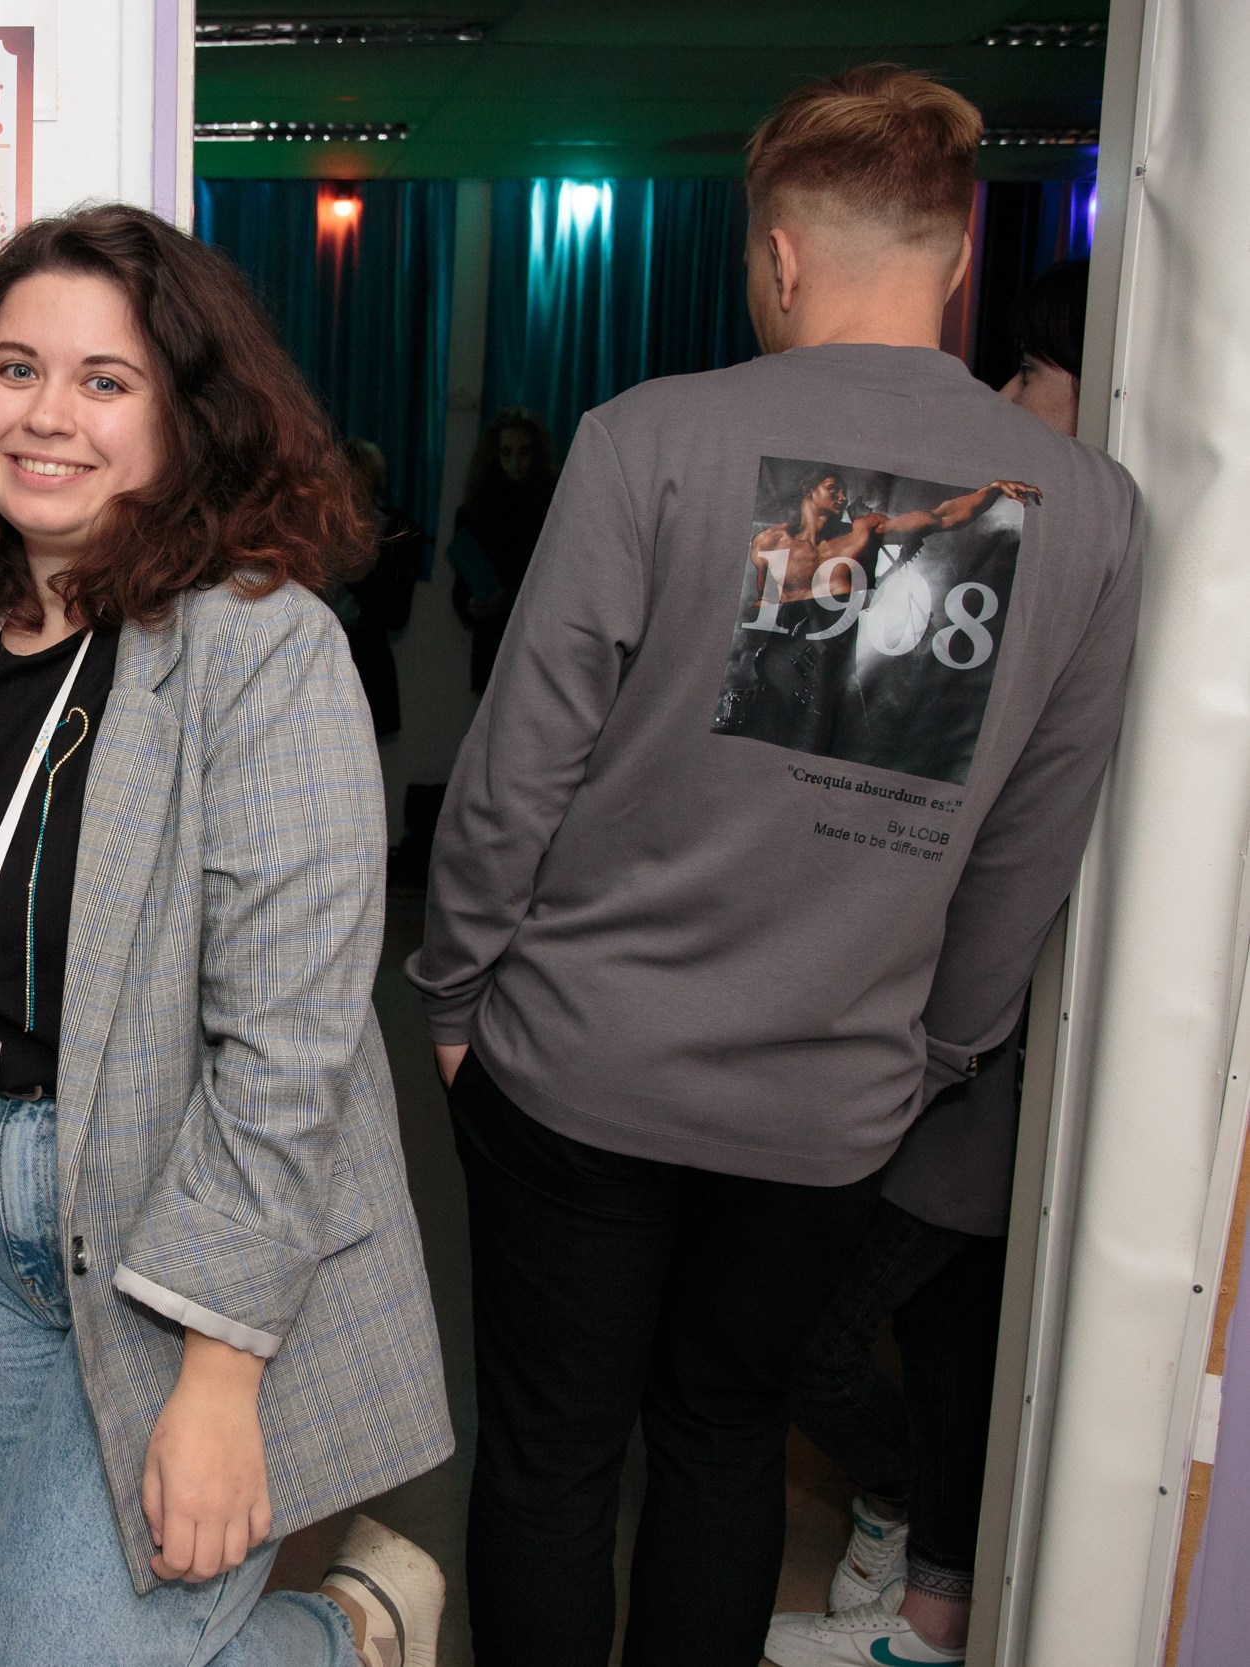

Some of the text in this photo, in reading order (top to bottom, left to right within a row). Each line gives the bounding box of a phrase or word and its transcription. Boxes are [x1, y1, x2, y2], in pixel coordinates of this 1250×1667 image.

[741, 548, 998, 670] 1908
[855, 781, 927, 807] absurdum
[813, 821, 943, 862] Made to be different
[888, 820, 950, 845] By LCDB
